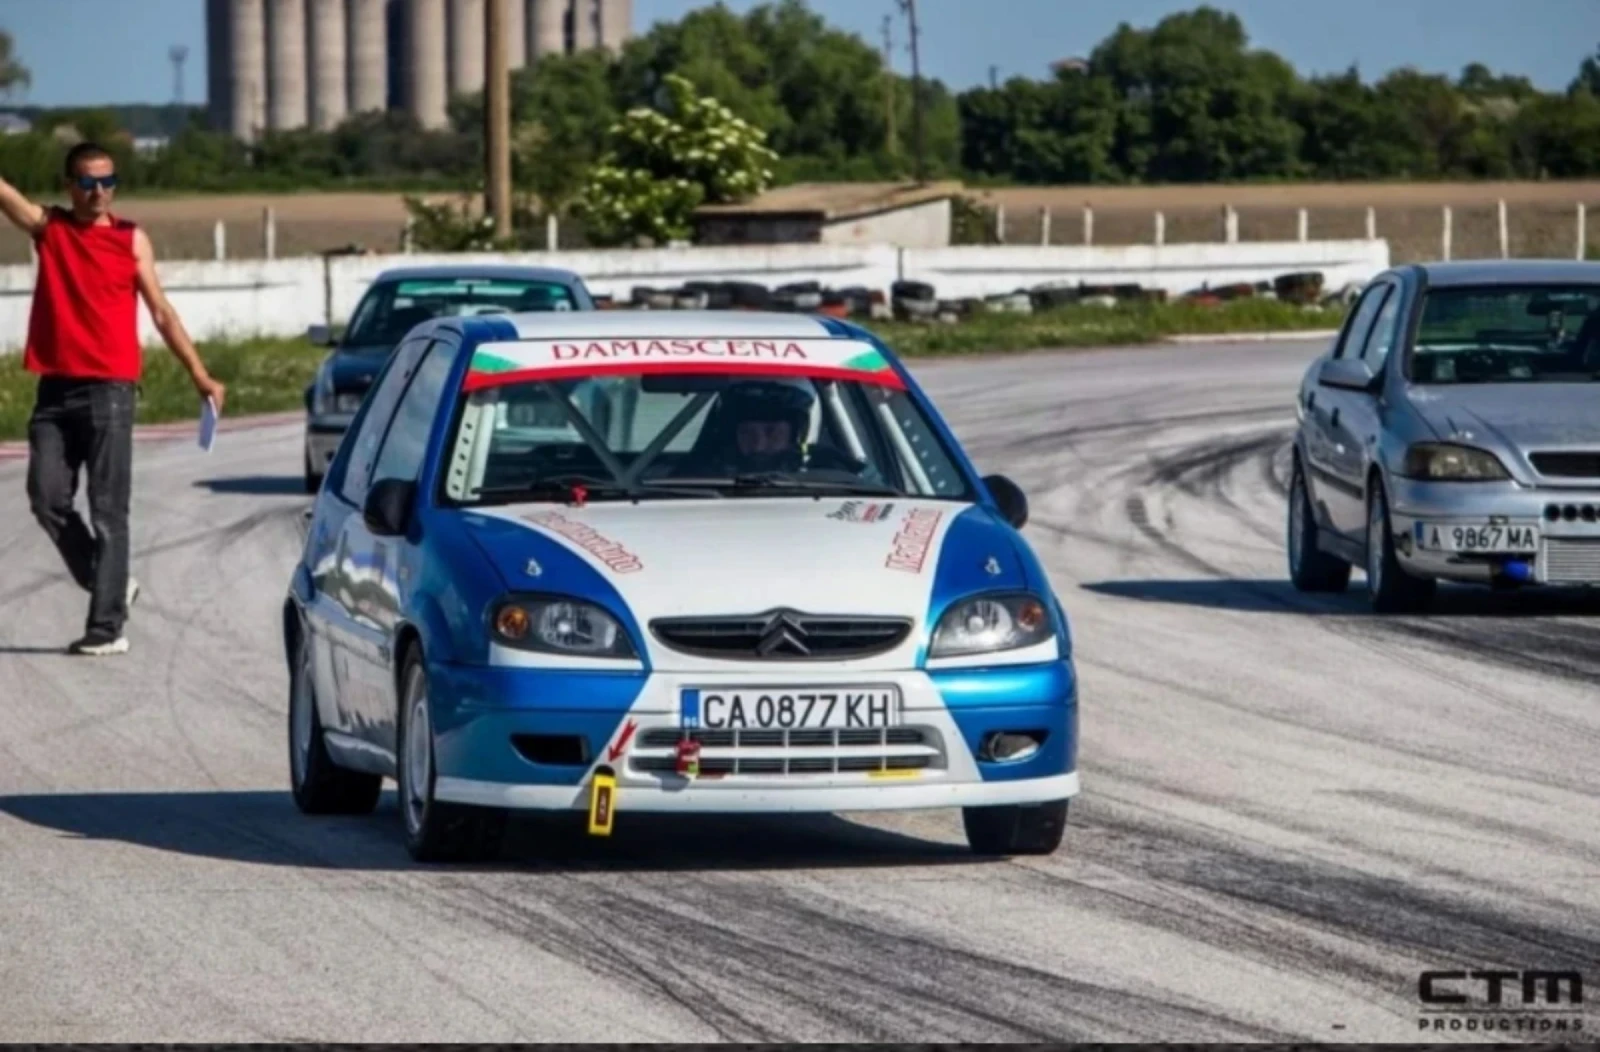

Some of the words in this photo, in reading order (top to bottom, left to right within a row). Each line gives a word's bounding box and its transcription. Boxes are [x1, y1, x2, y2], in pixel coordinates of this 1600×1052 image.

[551, 339, 808, 361] DAMASCENA
[1431, 528, 1441, 547] A
[1452, 527, 1503, 549] 9867
[1506, 527, 1535, 549] MA
[703, 694, 747, 728] CA
[755, 693, 838, 728] 0877
[845, 693, 889, 728] KH
